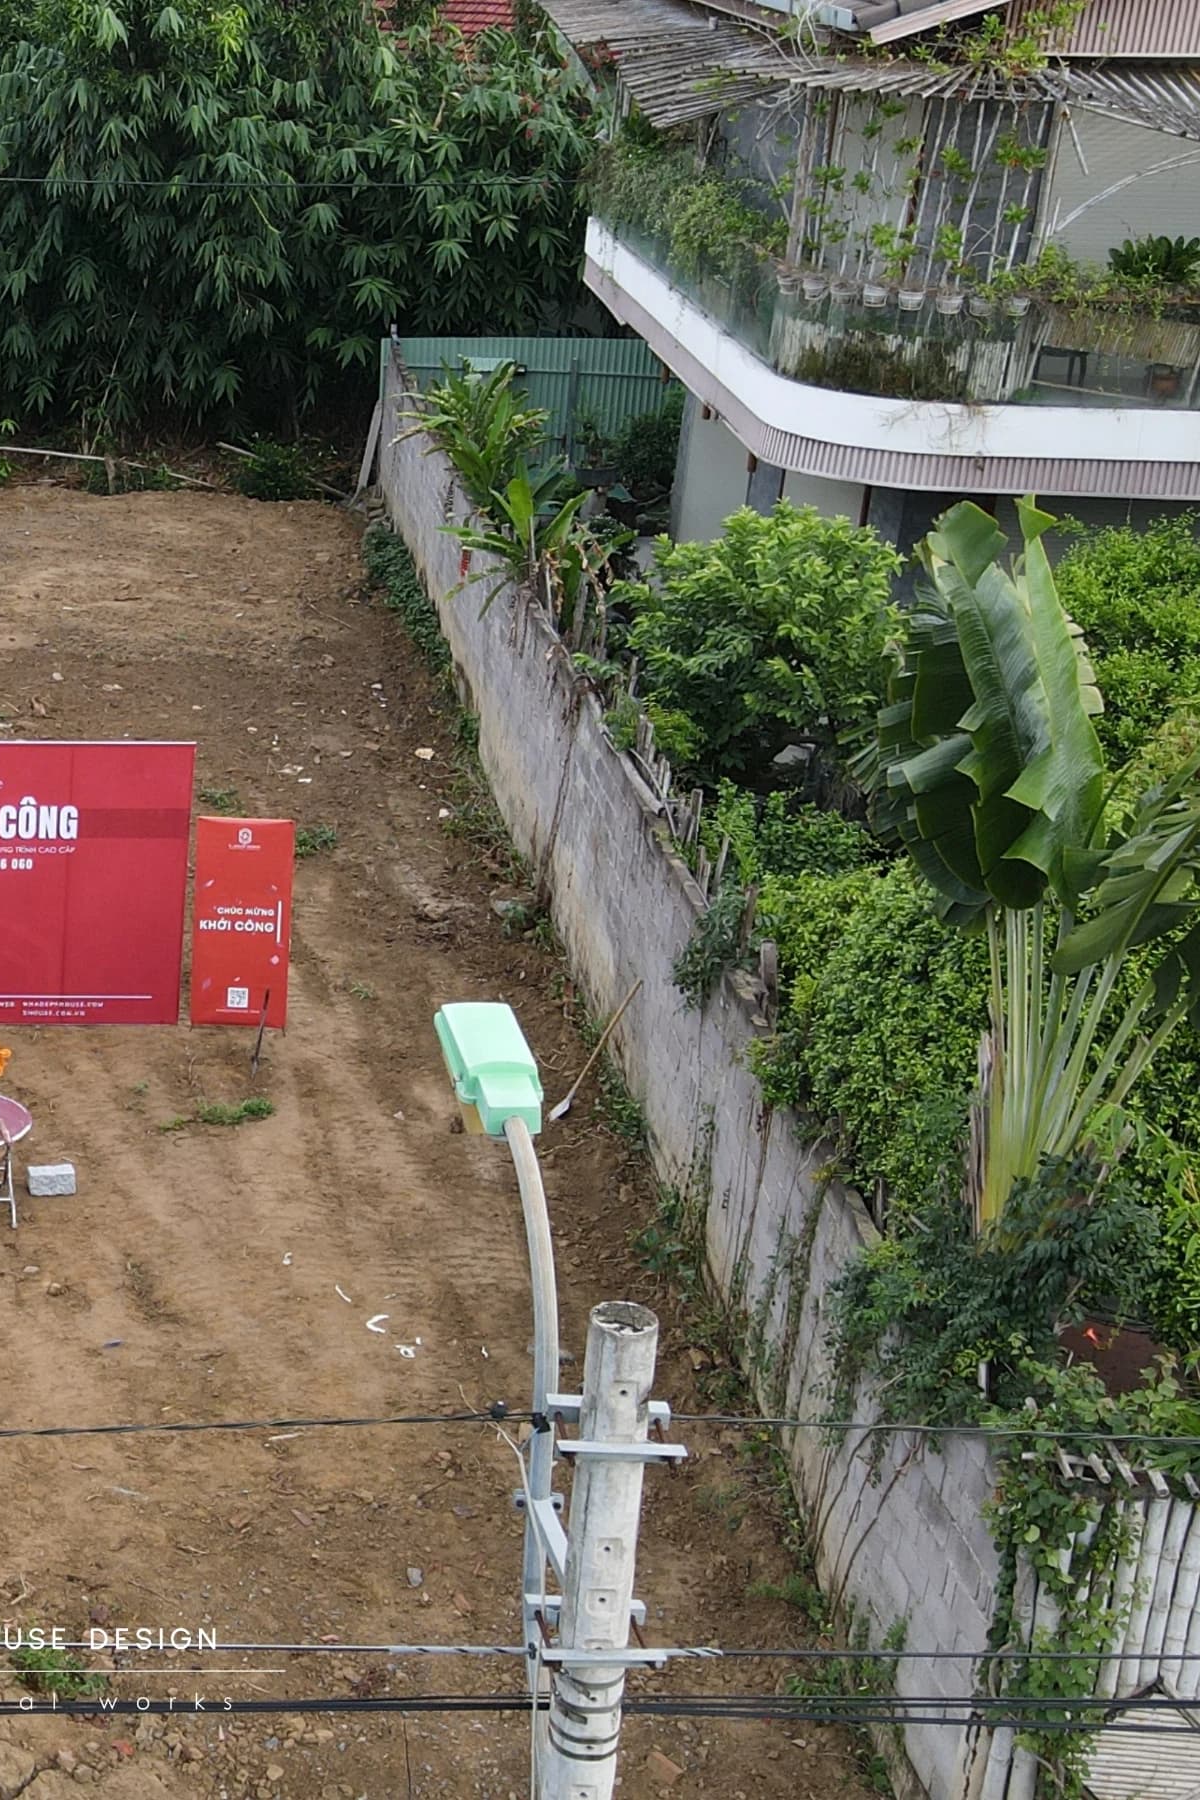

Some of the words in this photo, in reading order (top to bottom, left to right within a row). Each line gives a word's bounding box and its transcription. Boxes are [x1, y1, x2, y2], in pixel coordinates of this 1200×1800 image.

[217, 906, 243, 915] CHÚC
[199, 917, 231, 931] KHỞI
[234, 919, 274, 932] CÔNG
